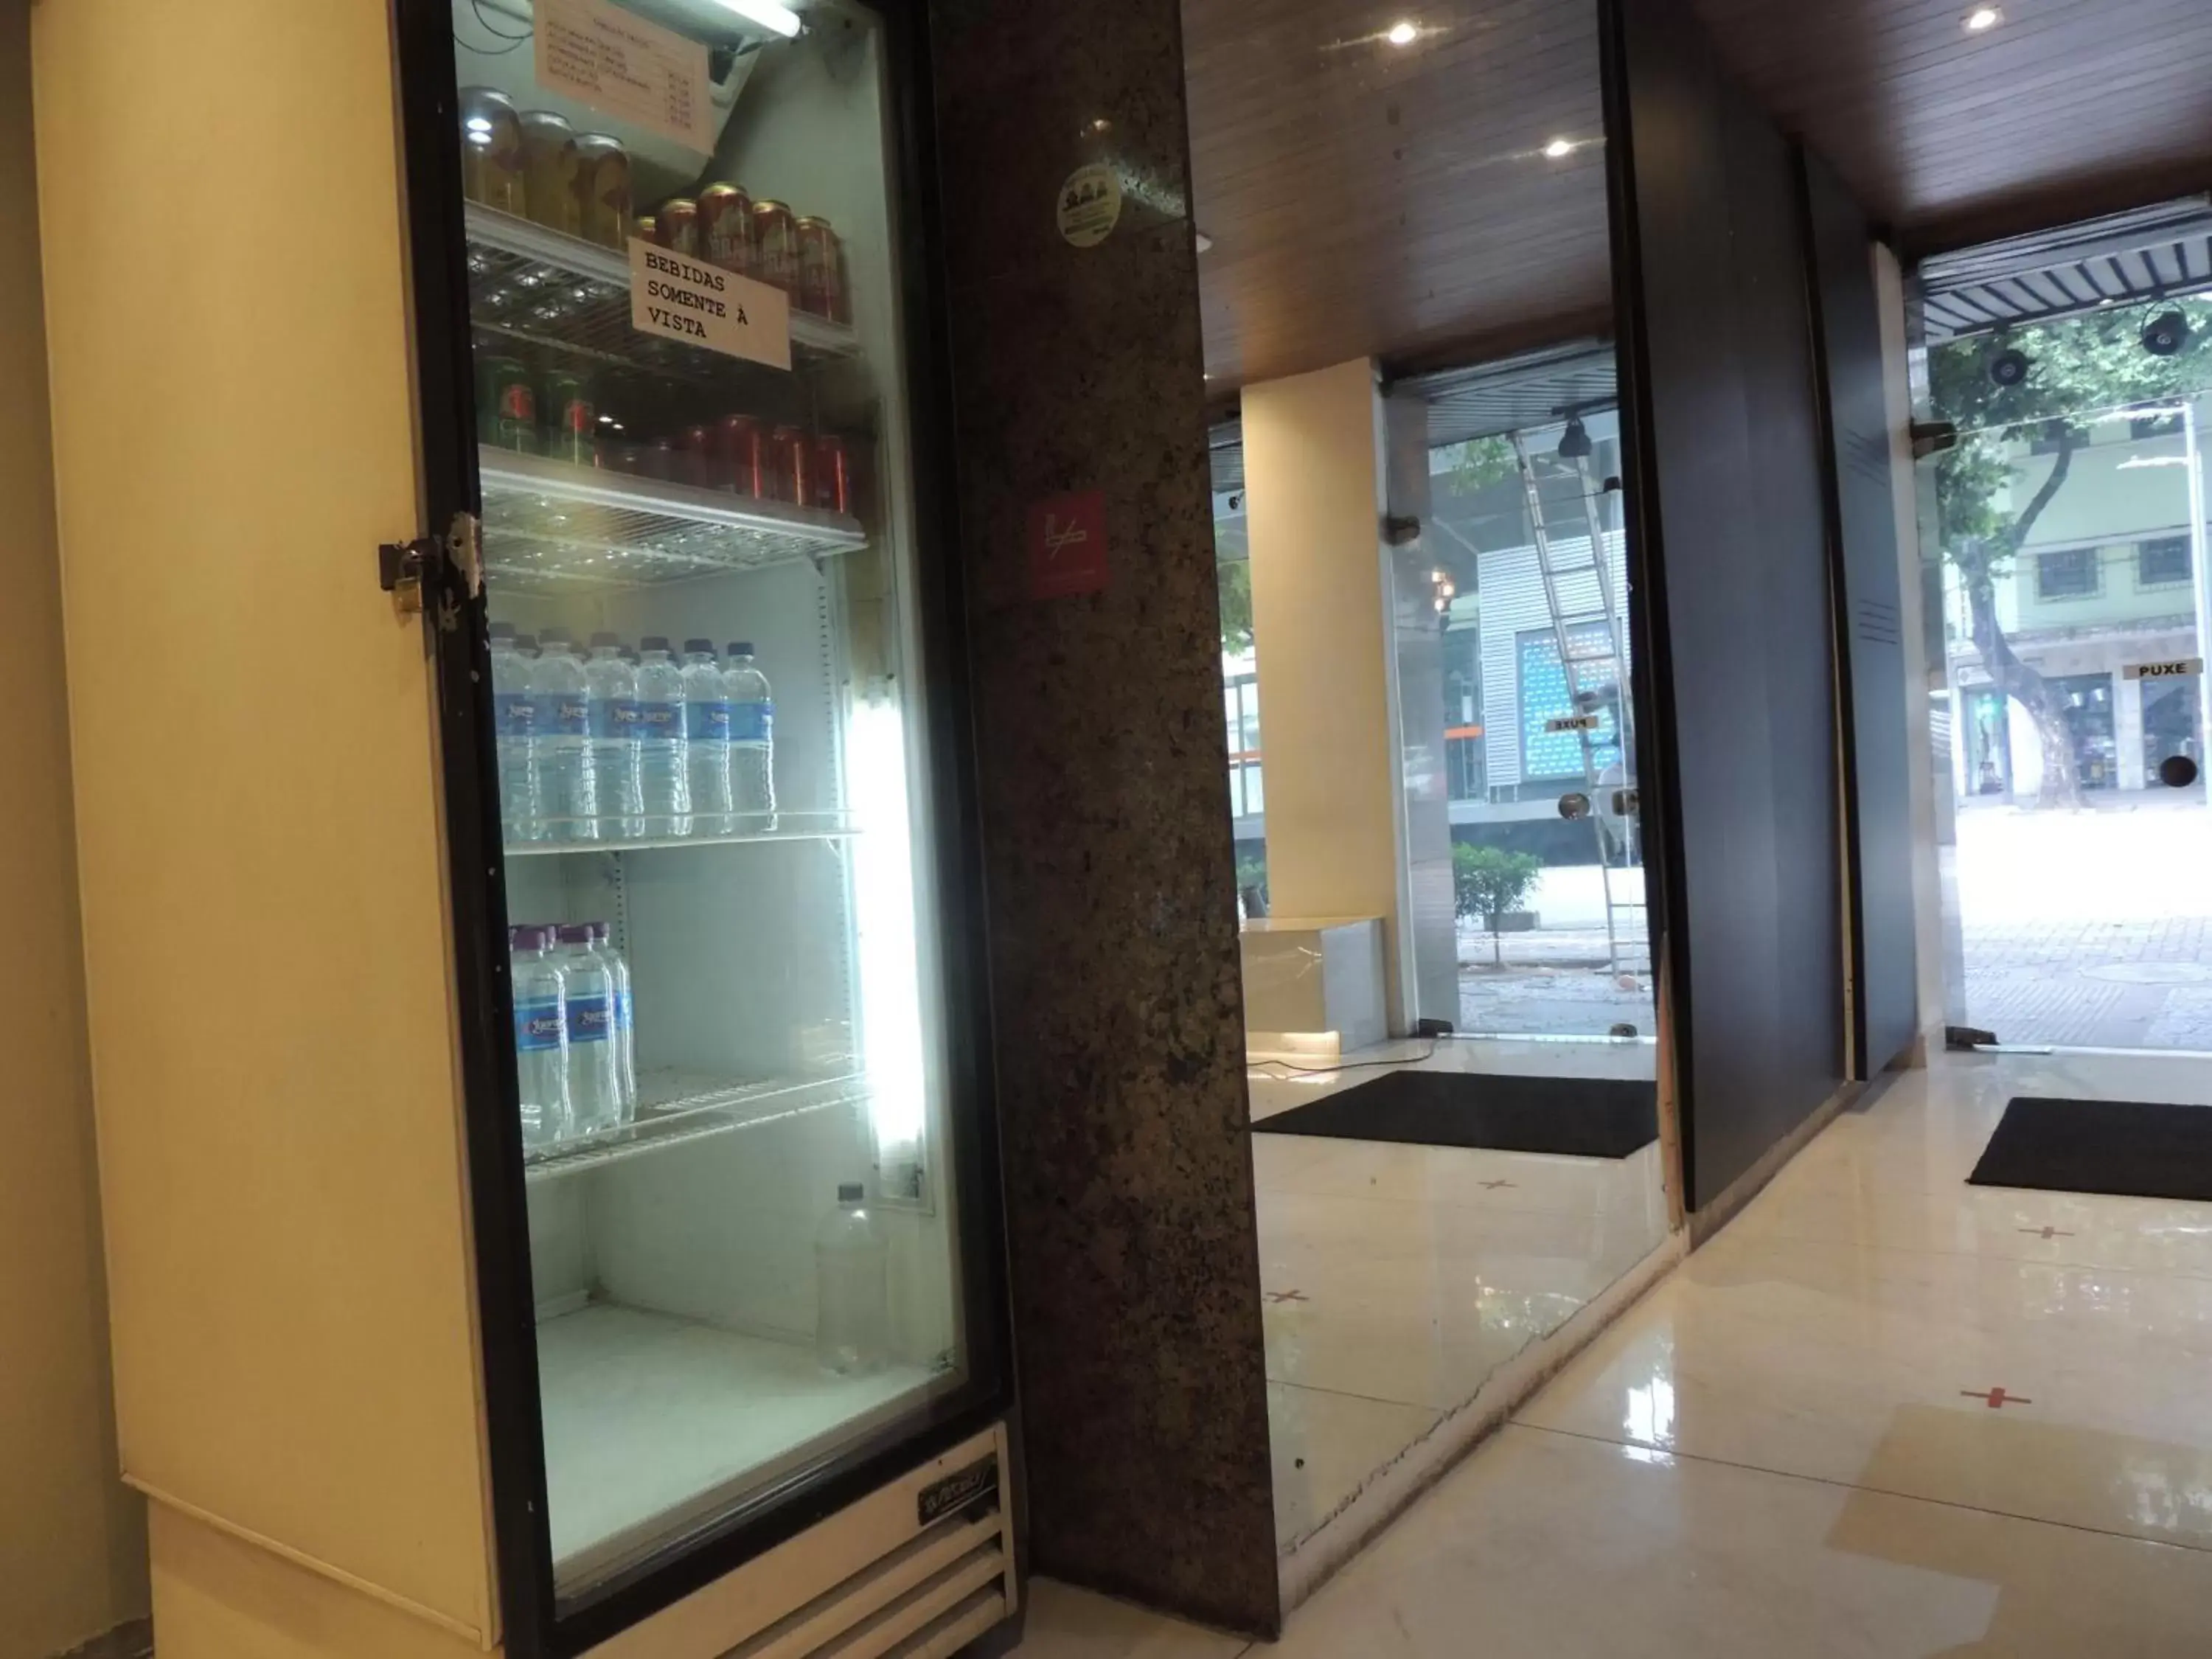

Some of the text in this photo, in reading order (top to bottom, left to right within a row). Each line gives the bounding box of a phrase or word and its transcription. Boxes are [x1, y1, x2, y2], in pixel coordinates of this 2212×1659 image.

[645, 252, 725, 291] BEBIDAS
[647, 279, 726, 318] SOMENTE
[647, 307, 707, 338] VISTA
[2139, 663, 2187, 677] PUXE
